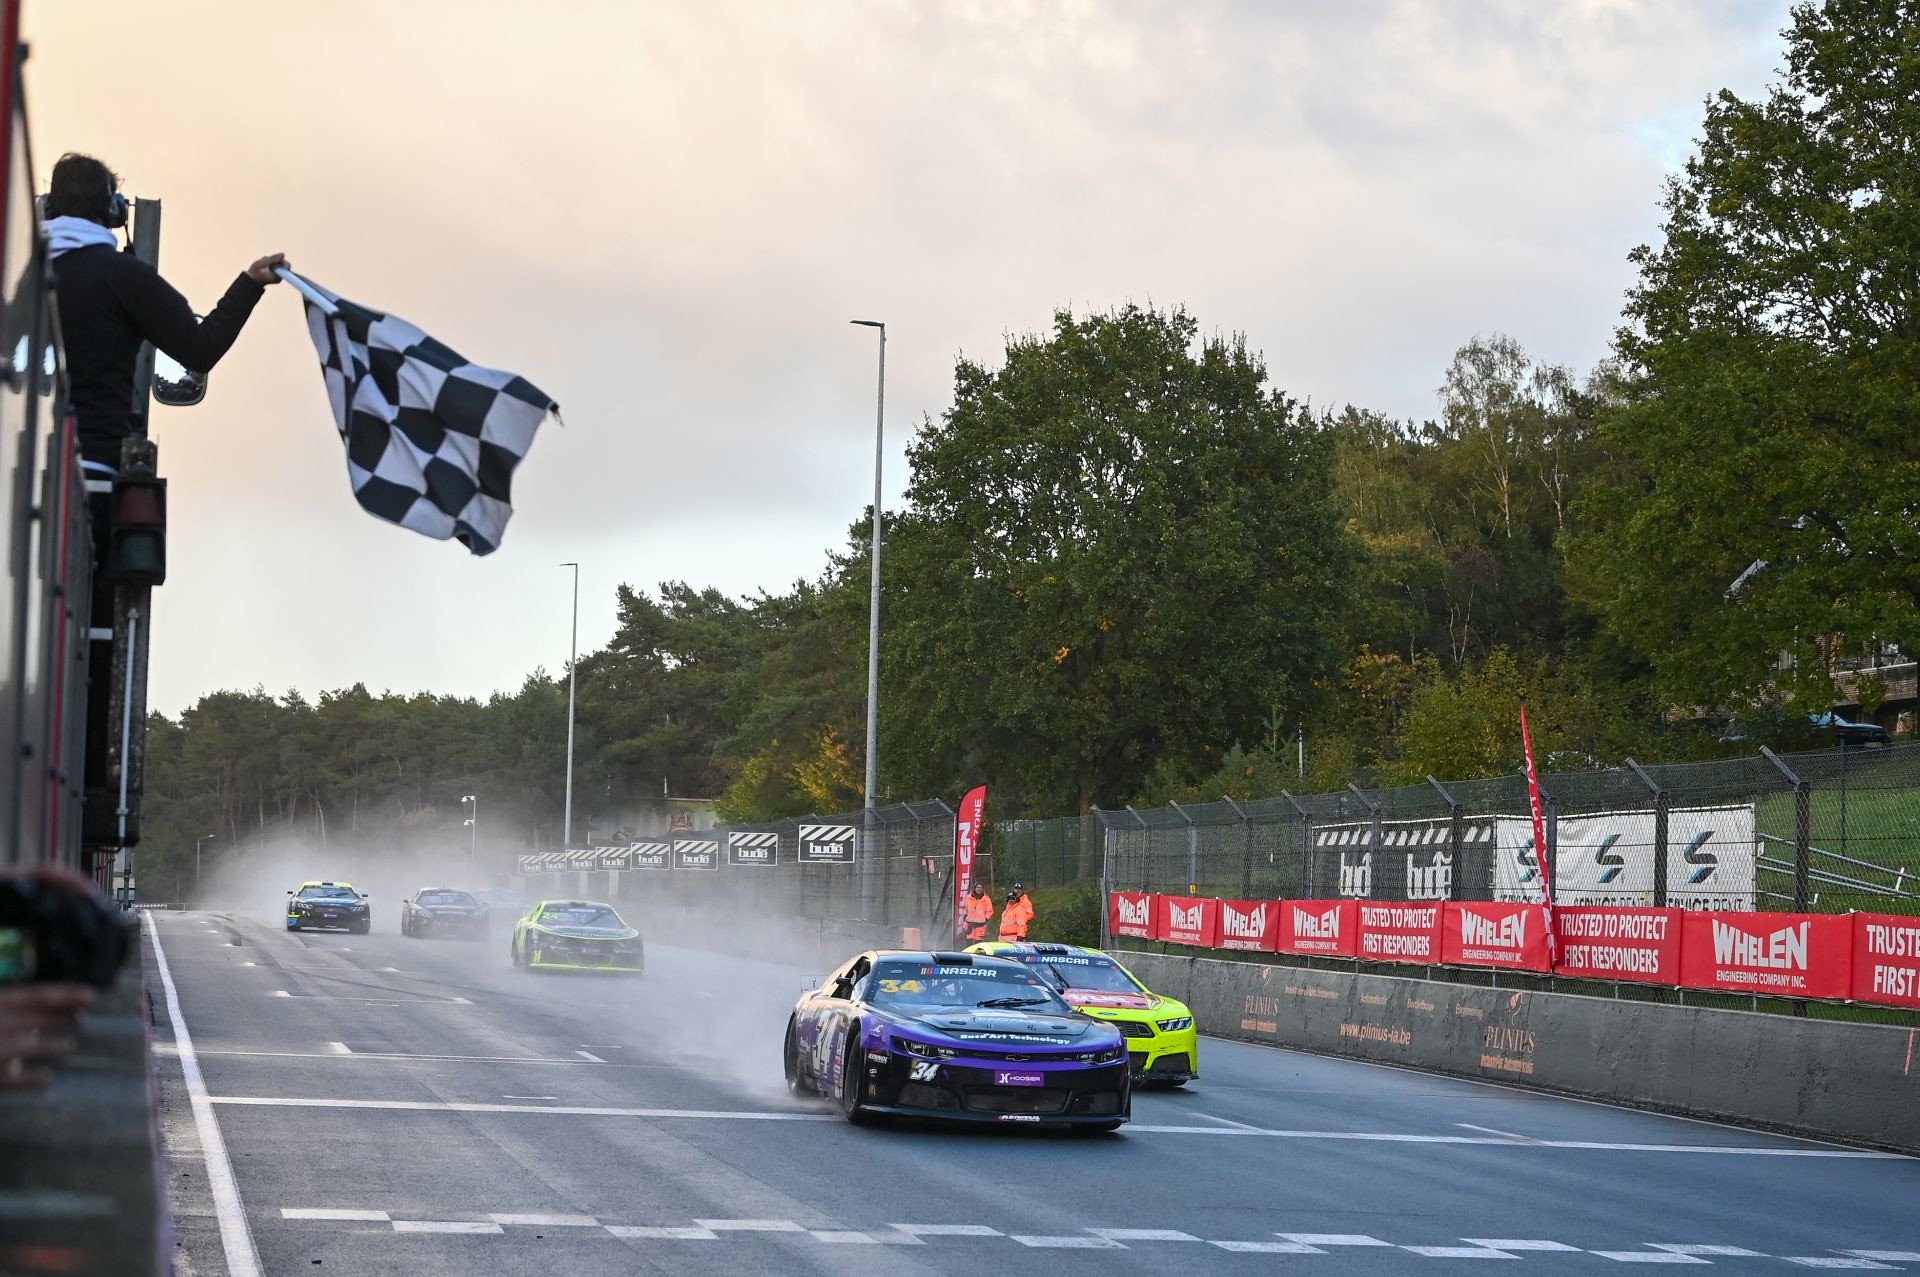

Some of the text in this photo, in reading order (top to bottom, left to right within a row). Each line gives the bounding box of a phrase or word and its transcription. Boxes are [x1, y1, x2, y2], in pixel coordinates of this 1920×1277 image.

[1118, 895, 1150, 925] WHELEN
[1170, 901, 1203, 930] WHELEN
[1223, 902, 1266, 937] WHELEN
[1293, 905, 1340, 938] WHELEN
[1361, 907, 1436, 929] TRUSTED TO PROTECT
[1461, 908, 1527, 948] WHELEN
[1560, 913, 1668, 940] TRUSTED TO PROTECT
[1363, 933, 1430, 956] FIRST RESPONDERS
[1462, 949, 1492, 961] ENGINEERING
[1493, 951, 1513, 962] COMPANY
[1712, 919, 1808, 970] WHELEN
[1041, 956, 1089, 965] NASCAR
[1564, 944, 1659, 974] FIRST RESPONDERS
[939, 967, 997, 978] NASCAR
[1716, 970, 1806, 988] ENGINEERING COMPANY INC.
[1873, 965, 1916, 997] FIRST
[878, 979, 922, 993] 34
[1244, 995, 1279, 1016] PLINIUS
[1009, 1034, 1070, 1045] Technology
[1340, 1022, 1411, 1046] www.plinius-ia.be
[1486, 1025, 1536, 1054] PLINIUS
[910, 1061, 940, 1081] 34
